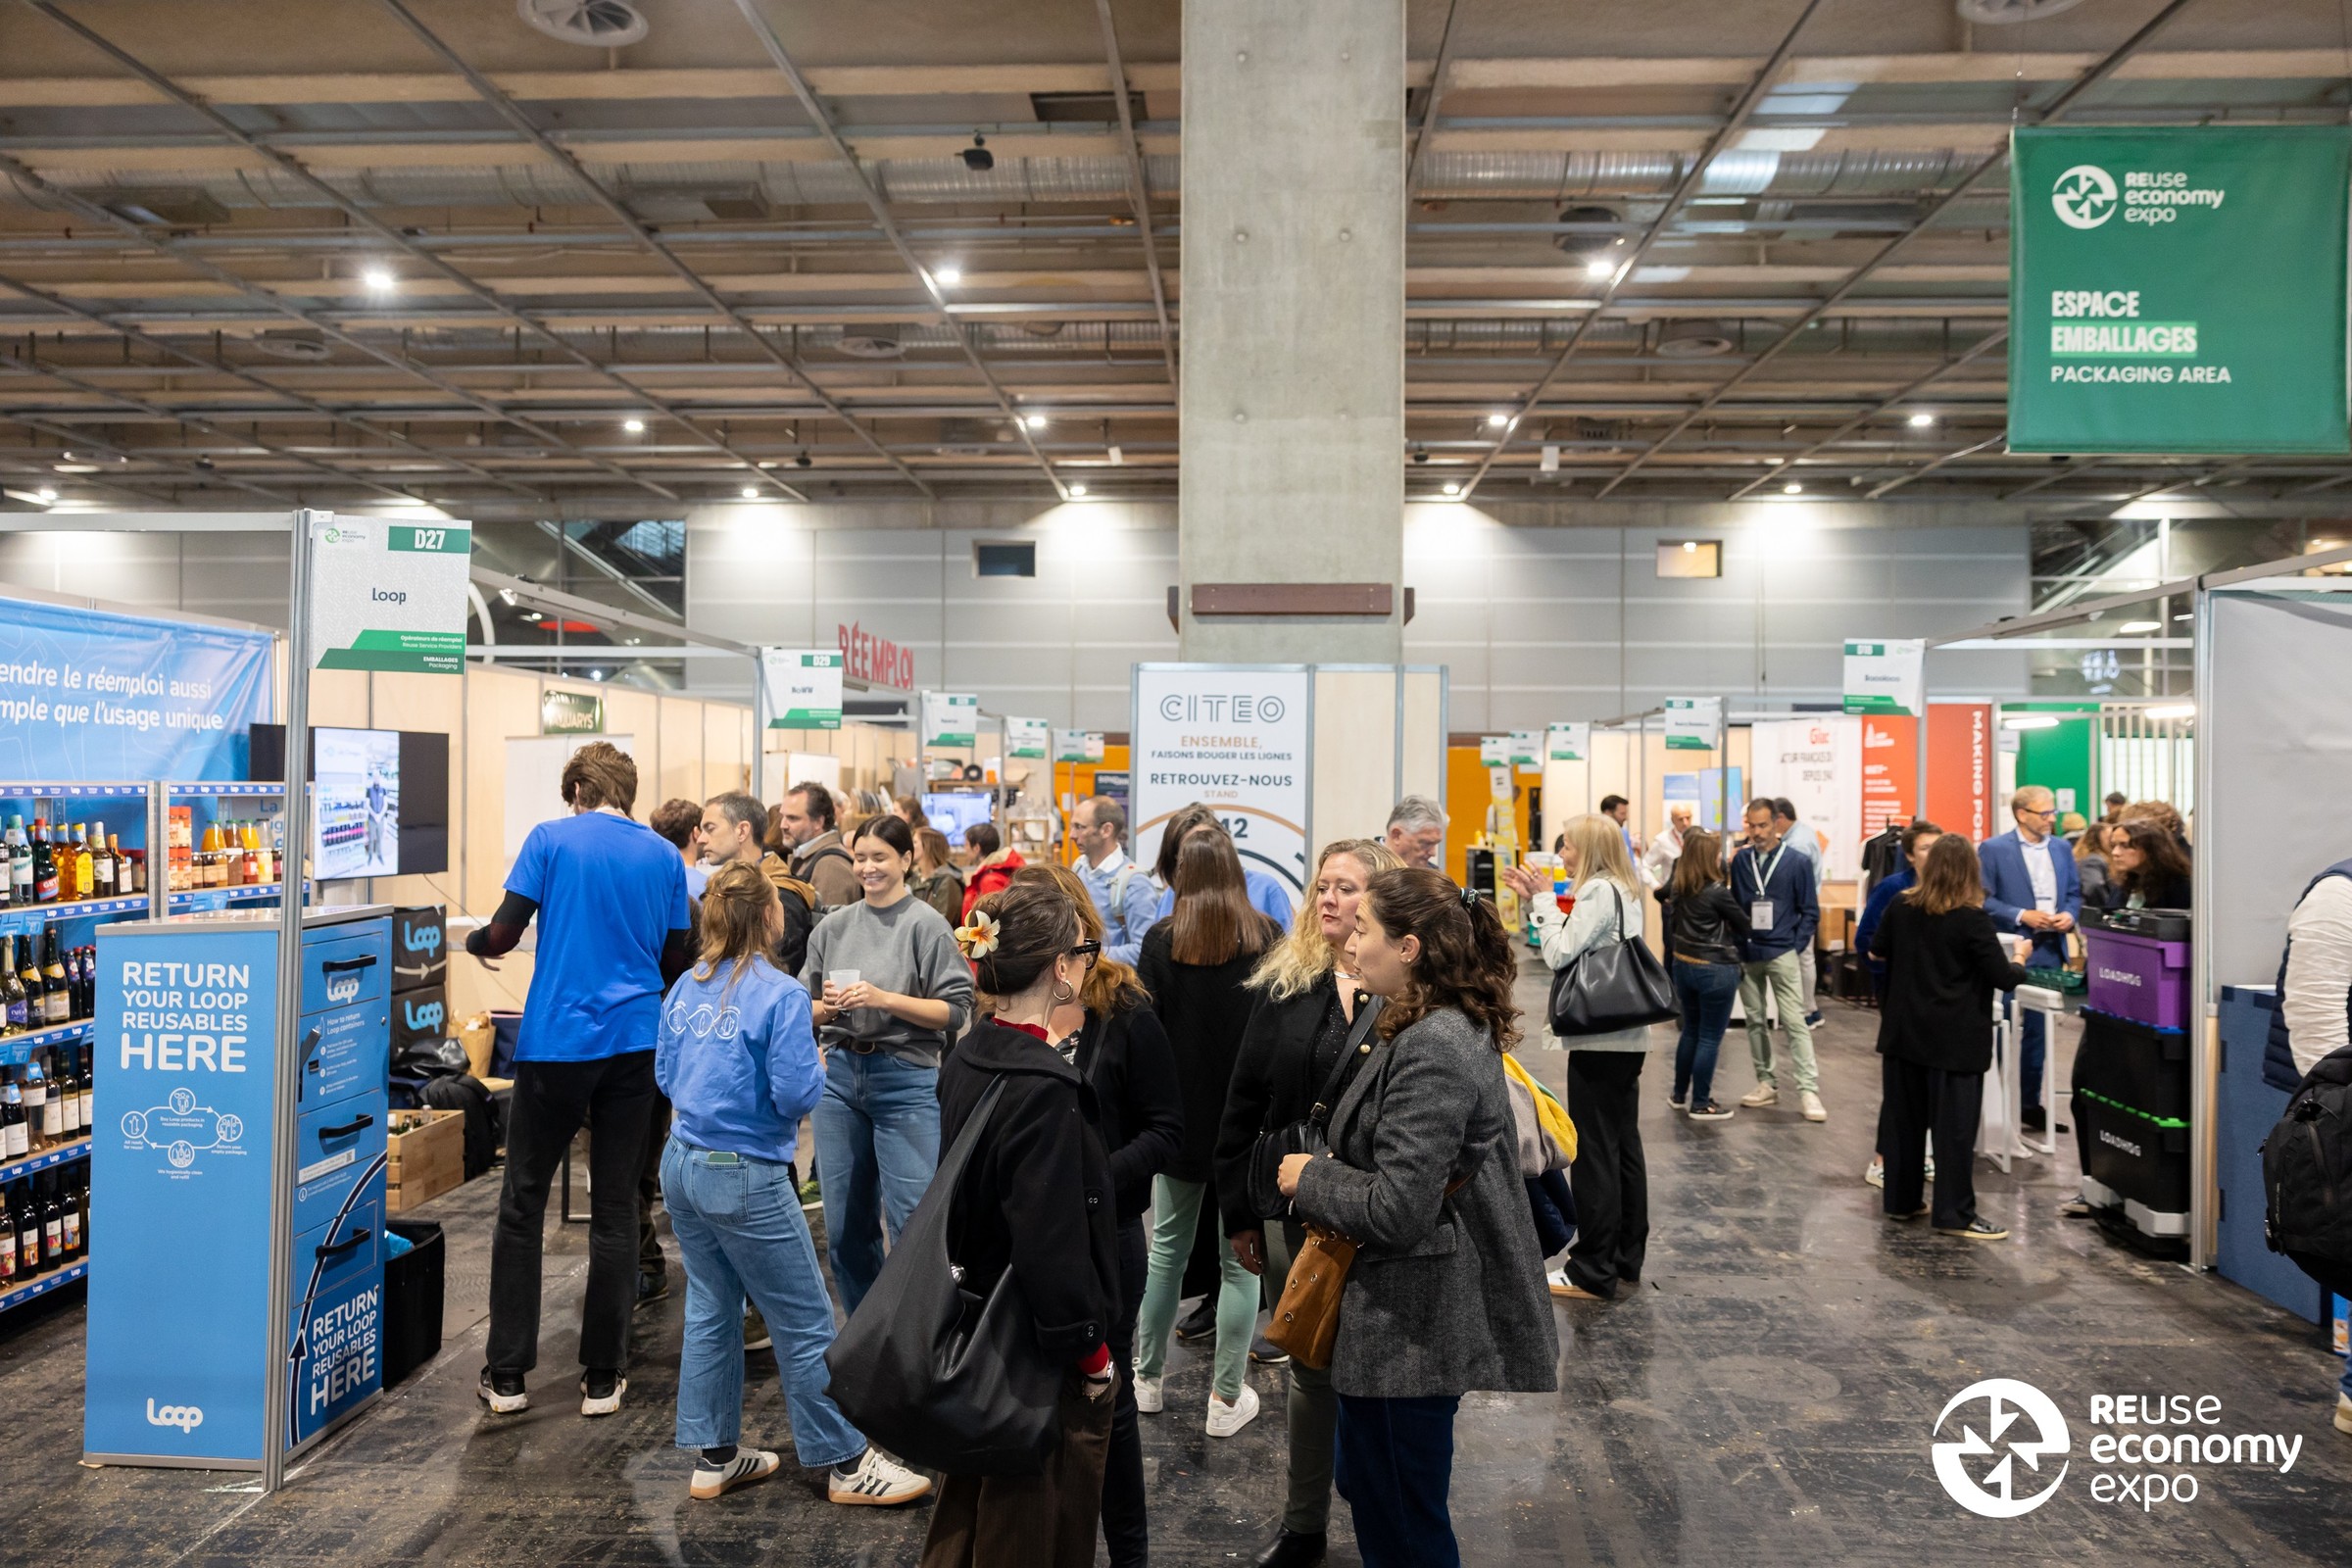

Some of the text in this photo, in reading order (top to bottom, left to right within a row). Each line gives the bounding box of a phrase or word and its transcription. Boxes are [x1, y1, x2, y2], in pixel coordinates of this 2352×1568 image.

[2124, 189, 2225, 210] economy
[2124, 207, 2177, 226] expo
[2051, 290, 2139, 318] ESPACE
[2051, 325, 2198, 353] EMBALLAGES
[2051, 366, 2231, 383] PACKAGING AREA
[415, 529, 446, 550] D27
[372, 588, 407, 605] Loop
[838, 620, 913, 690] RÉEMPLOI
[0, 660, 212, 699] endre le réemploi aussi
[0, 695, 223, 733] mple que l'usage unique
[1160, 694, 1285, 723] CITEO
[1152, 751, 1194, 760] FAISONS
[1240, 752, 1255, 760] LES
[1257, 752, 1292, 760] LIGNES
[1181, 736, 1262, 750] ENSEMBLE,
[1972, 710, 1984, 796] MAKING
[1151, 773, 1292, 786] RETROUVEZ-NOUS
[260, 799, 277, 812] La
[1203, 790, 1238, 799] STAND
[405, 920, 440, 957] Loop
[122, 961, 249, 989] RETURN
[122, 990, 248, 1009] YOUR LOOP
[327, 976, 359, 1004] Loop
[122, 1011, 248, 1032] REUSABLES
[326, 1020, 365, 1035] Loop containers
[345, 1012, 361, 1021] return
[405, 1000, 443, 1034] Loop
[121, 1032, 247, 1072] HERE
[313, 1289, 377, 1341] RETURN
[313, 1309, 376, 1358] YOUR LOOP
[313, 1328, 376, 1379] REUSABLES
[311, 1346, 375, 1416] HERE
[146, 1397, 204, 1434] Loop
